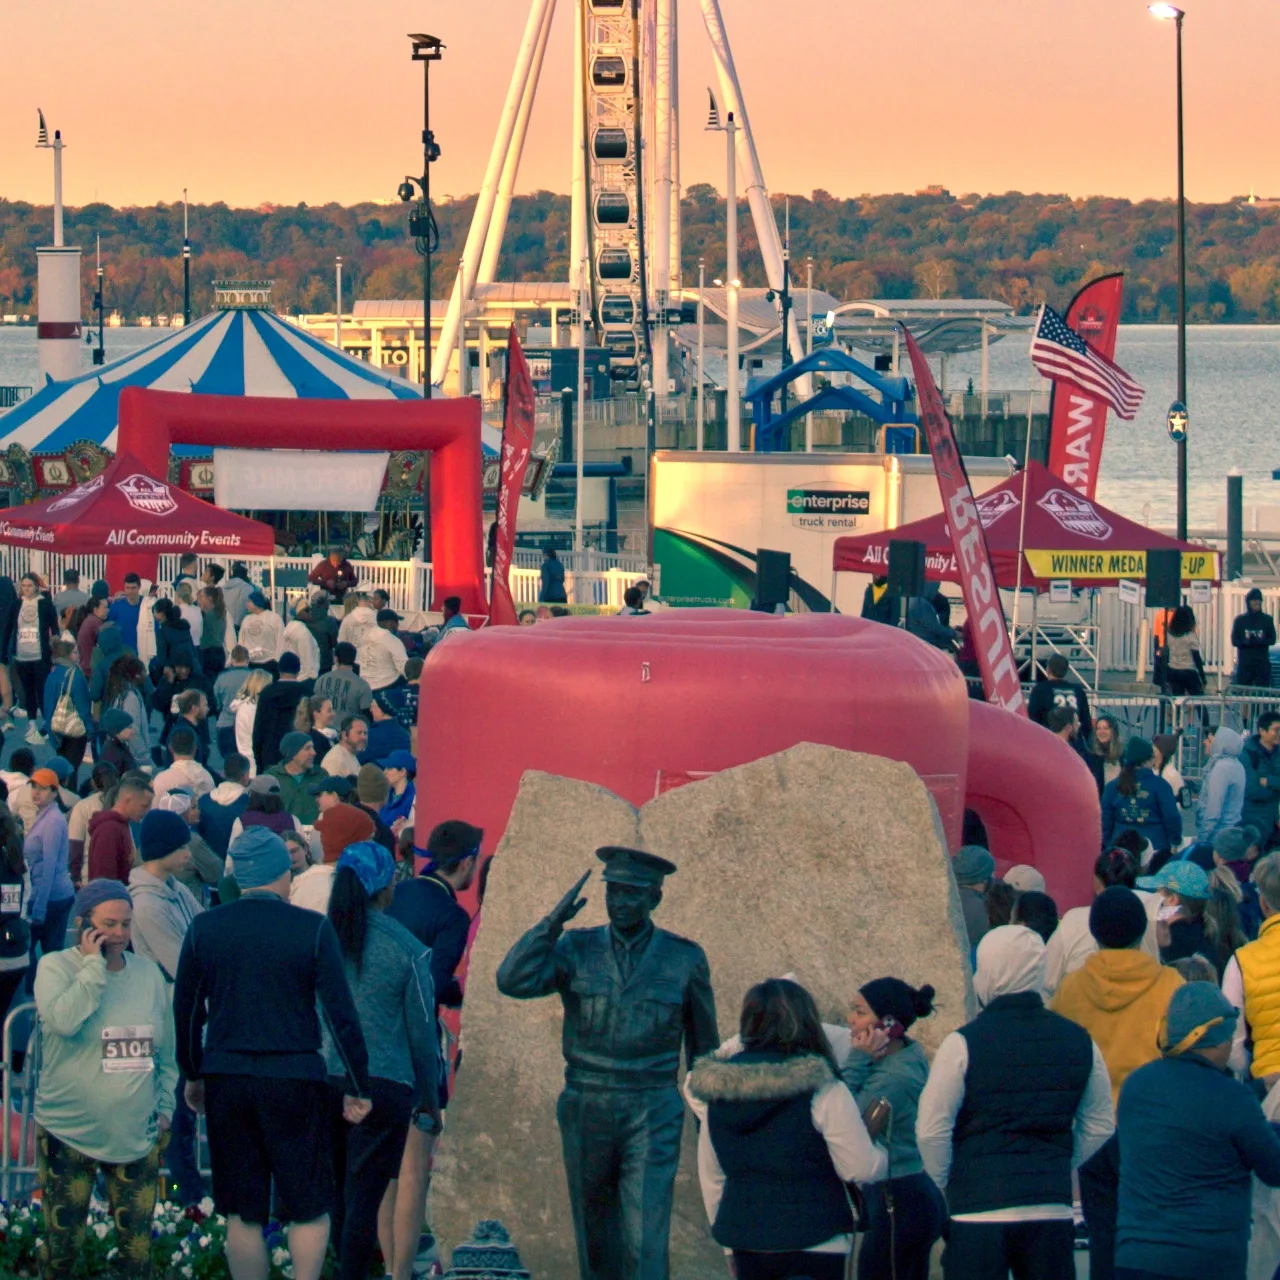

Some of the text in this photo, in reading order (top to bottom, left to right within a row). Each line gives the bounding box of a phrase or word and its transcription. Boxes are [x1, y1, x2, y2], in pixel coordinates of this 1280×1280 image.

[791, 494, 869, 511] enterprise
[799, 517, 857, 528] truck rental
[105, 529, 241, 549] All Community Events
[862, 544, 882, 563] All
[1051, 554, 1104, 573] WINNER
[1108, 555, 1144, 574] MEDA
[105, 1041, 151, 1058] 5104
